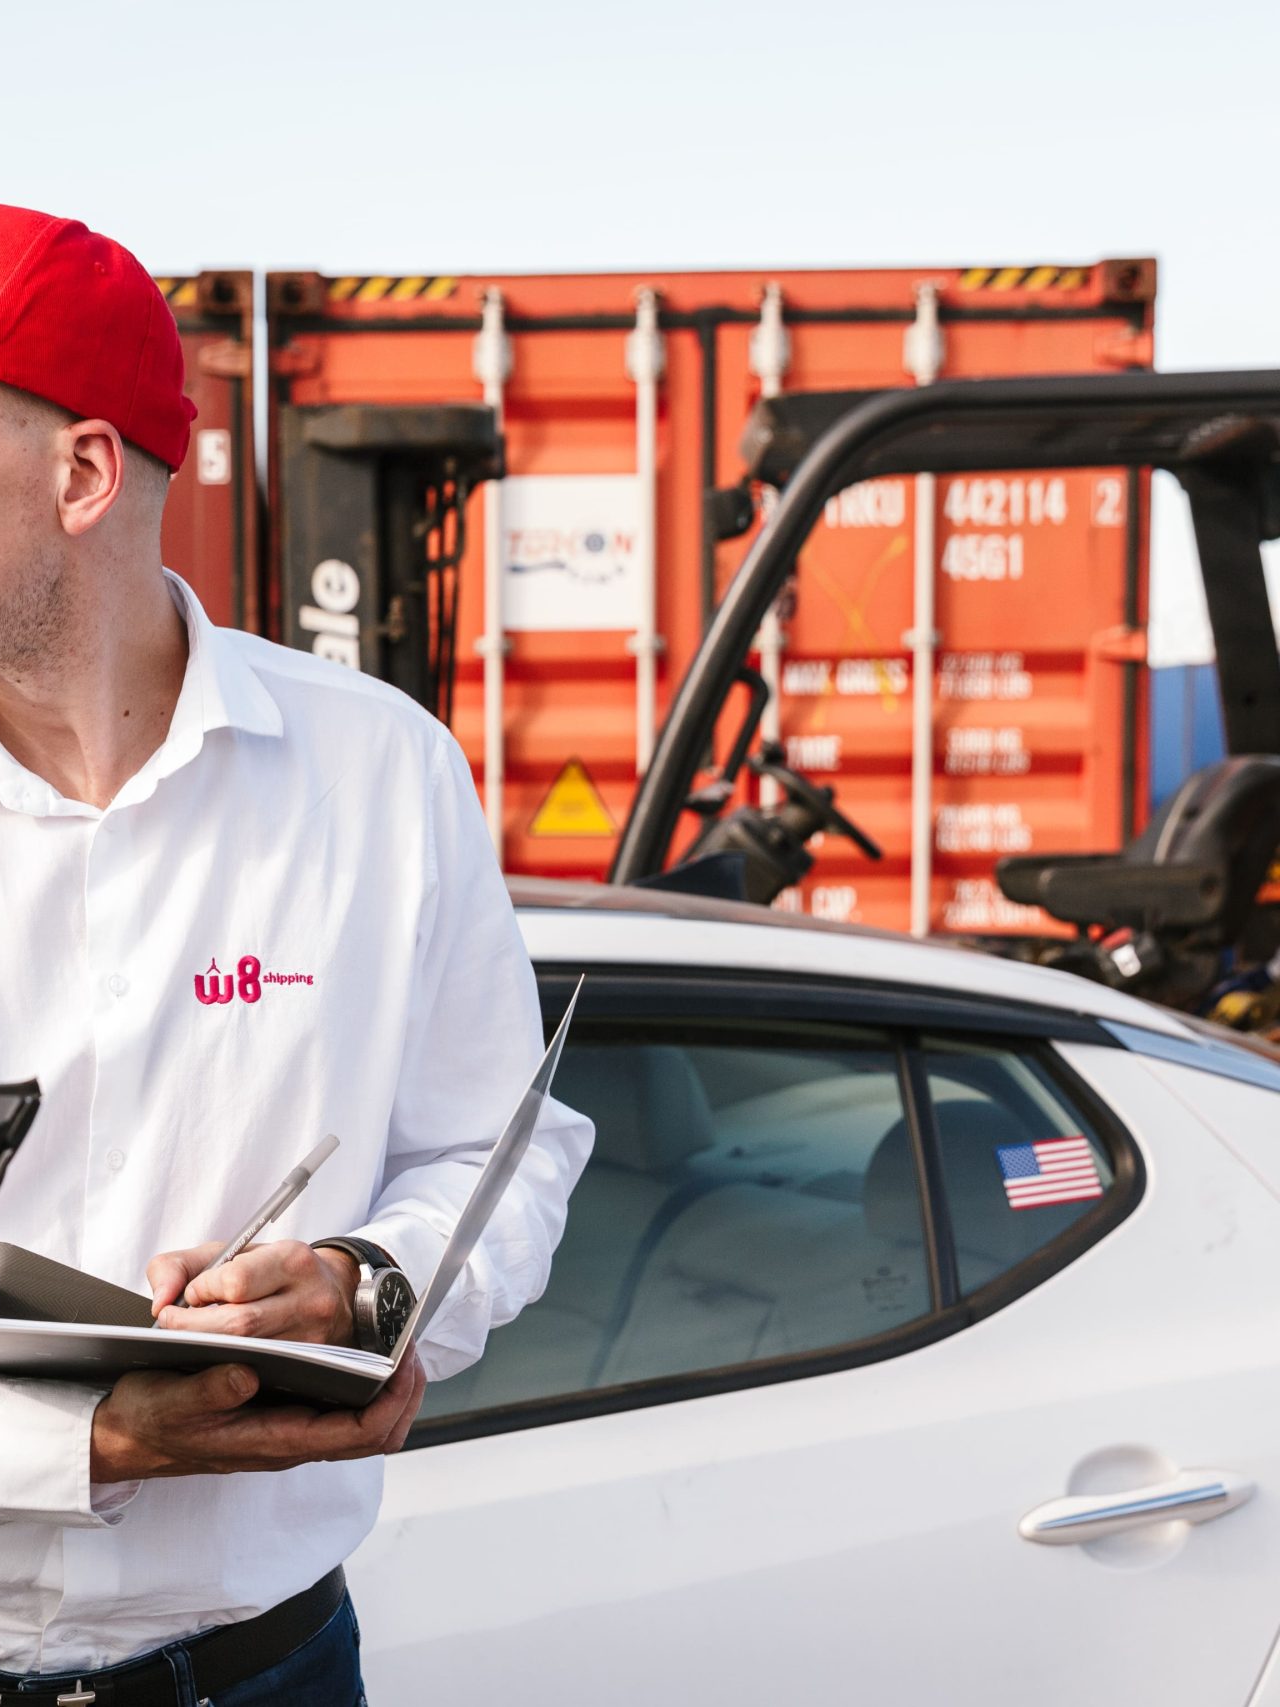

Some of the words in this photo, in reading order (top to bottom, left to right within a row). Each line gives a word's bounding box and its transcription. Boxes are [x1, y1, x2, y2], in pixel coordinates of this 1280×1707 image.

[199, 431, 229, 482] 5
[944, 479, 1068, 526] 442114
[1094, 479, 1123, 528] 2
[262, 971, 314, 986] shipping
